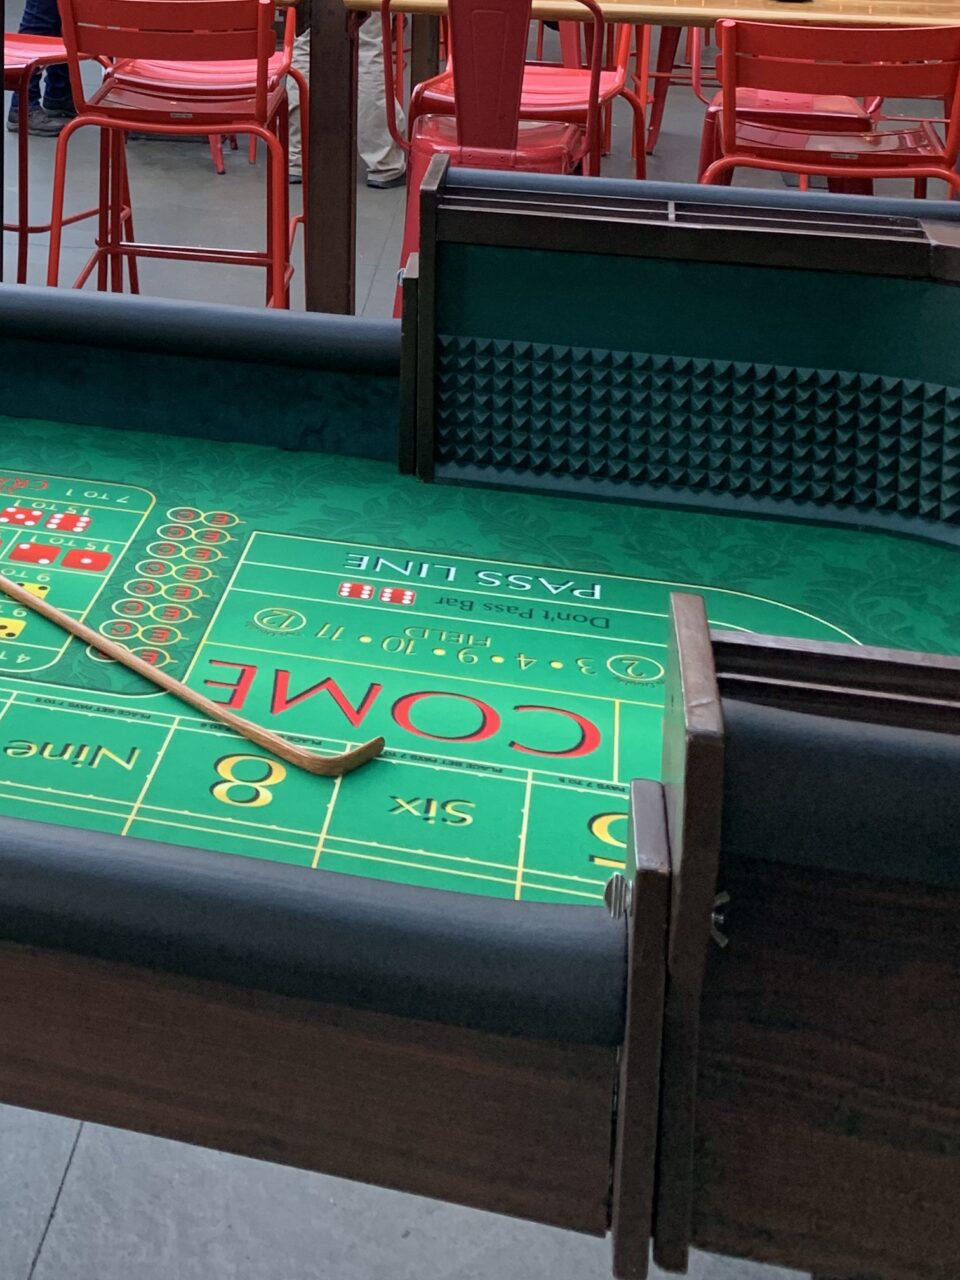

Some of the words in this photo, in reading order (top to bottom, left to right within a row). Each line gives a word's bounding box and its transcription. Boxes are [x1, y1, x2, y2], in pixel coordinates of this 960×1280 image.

[83, 489, 110, 501] TO
[116, 494, 131, 504] 7
[30, 500, 58, 512] TO
[64, 505, 91, 517] 15
[176, 509, 195, 522] C
[210, 513, 229, 525] E
[166, 526, 186, 539] C
[201, 530, 220, 543] E
[48, 535, 76, 548] TO
[86, 539, 111, 552] 15
[156, 543, 176, 556] C
[192, 548, 212, 561] E
[0, 567, 29, 580] TO
[145, 561, 165, 574] C
[181, 567, 202, 580] E
[342, 552, 458, 582] LINE
[36, 573, 51, 582] 9
[134, 581, 155, 594] C
[476, 570, 602, 600] PASS
[171, 586, 191, 598] E
[123, 600, 144, 614] C
[433, 597, 475, 613] Bar
[483, 602, 533, 619] Pass
[13, 606, 28, 618] 9
[159, 606, 180, 619] E
[542, 610, 610, 630] Don't
[111, 621, 132, 635] C
[149, 627, 170, 642] E
[315, 622, 345, 641] 11
[403, 626, 492, 649] FIELD
[382, 635, 418, 657] 10
[15, 652, 31, 664] 4
[456, 647, 478, 664] 9
[516, 653, 537, 671] 4
[576, 657, 598, 675] 3
[203, 659, 601, 759] COME
[3, 740, 140, 771] Nine
[209, 753, 287, 809] 8
[387, 796, 476, 827] Six
